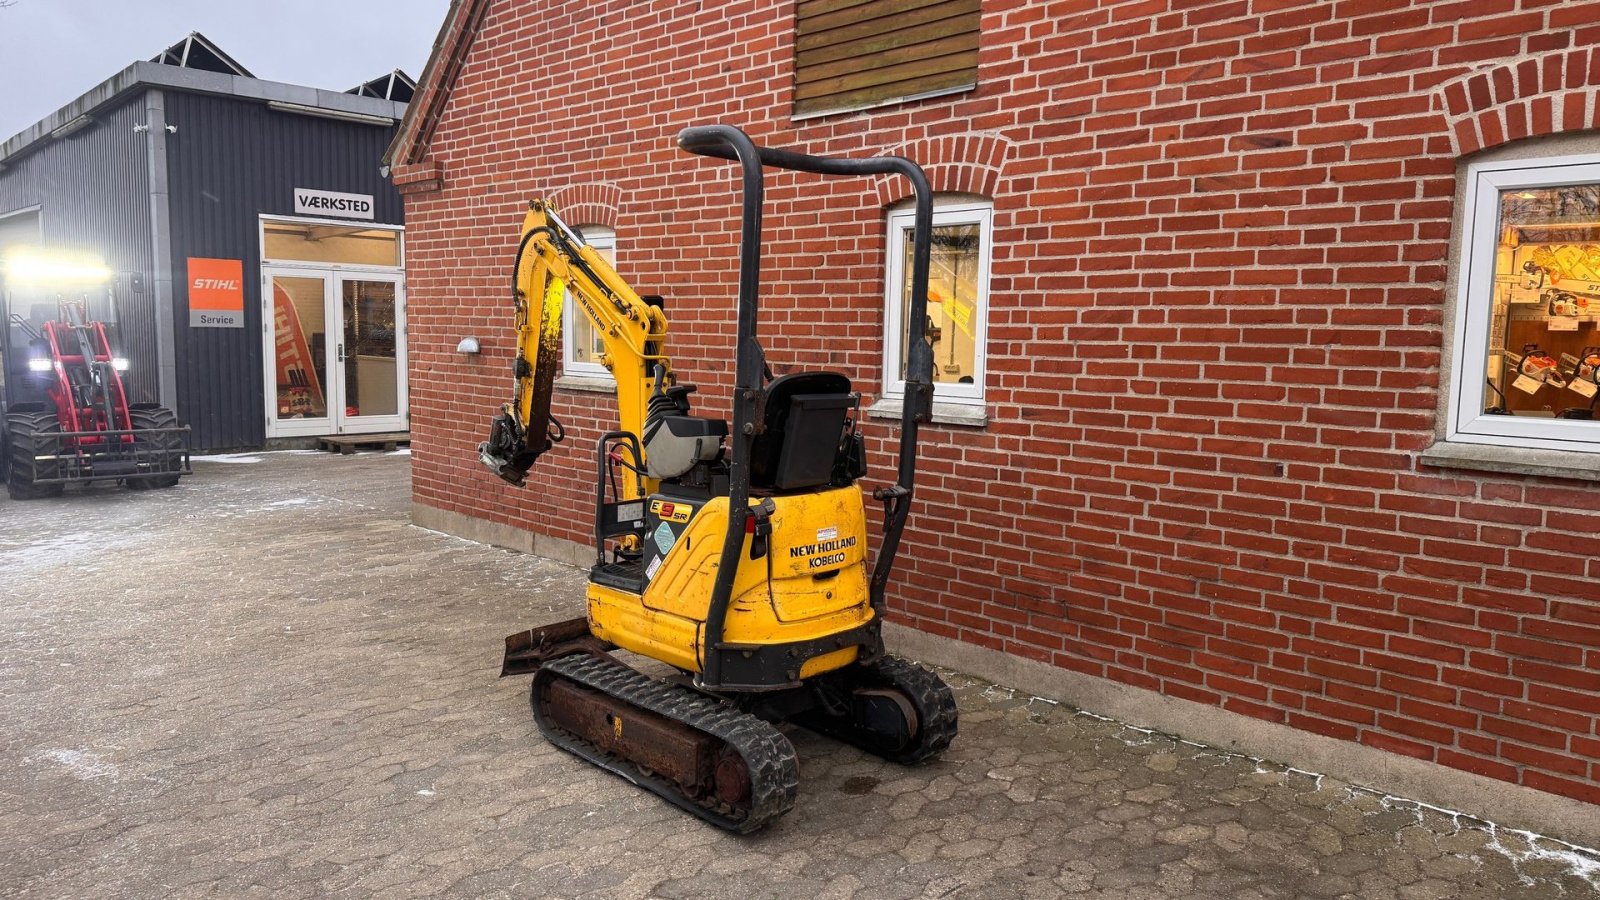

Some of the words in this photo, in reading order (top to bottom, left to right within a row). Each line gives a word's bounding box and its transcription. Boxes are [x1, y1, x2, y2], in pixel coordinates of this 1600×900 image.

[299, 195, 370, 212] VÆRKSTED
[193, 278, 239, 290] STIHL
[577, 291, 588, 306] NEW
[586, 303, 606, 331] HOLLAND
[200, 315, 234, 325] Service
[790, 544, 816, 558] NEW
[818, 535, 856, 553] HOLLAND
[809, 552, 845, 568] KOBELCO
